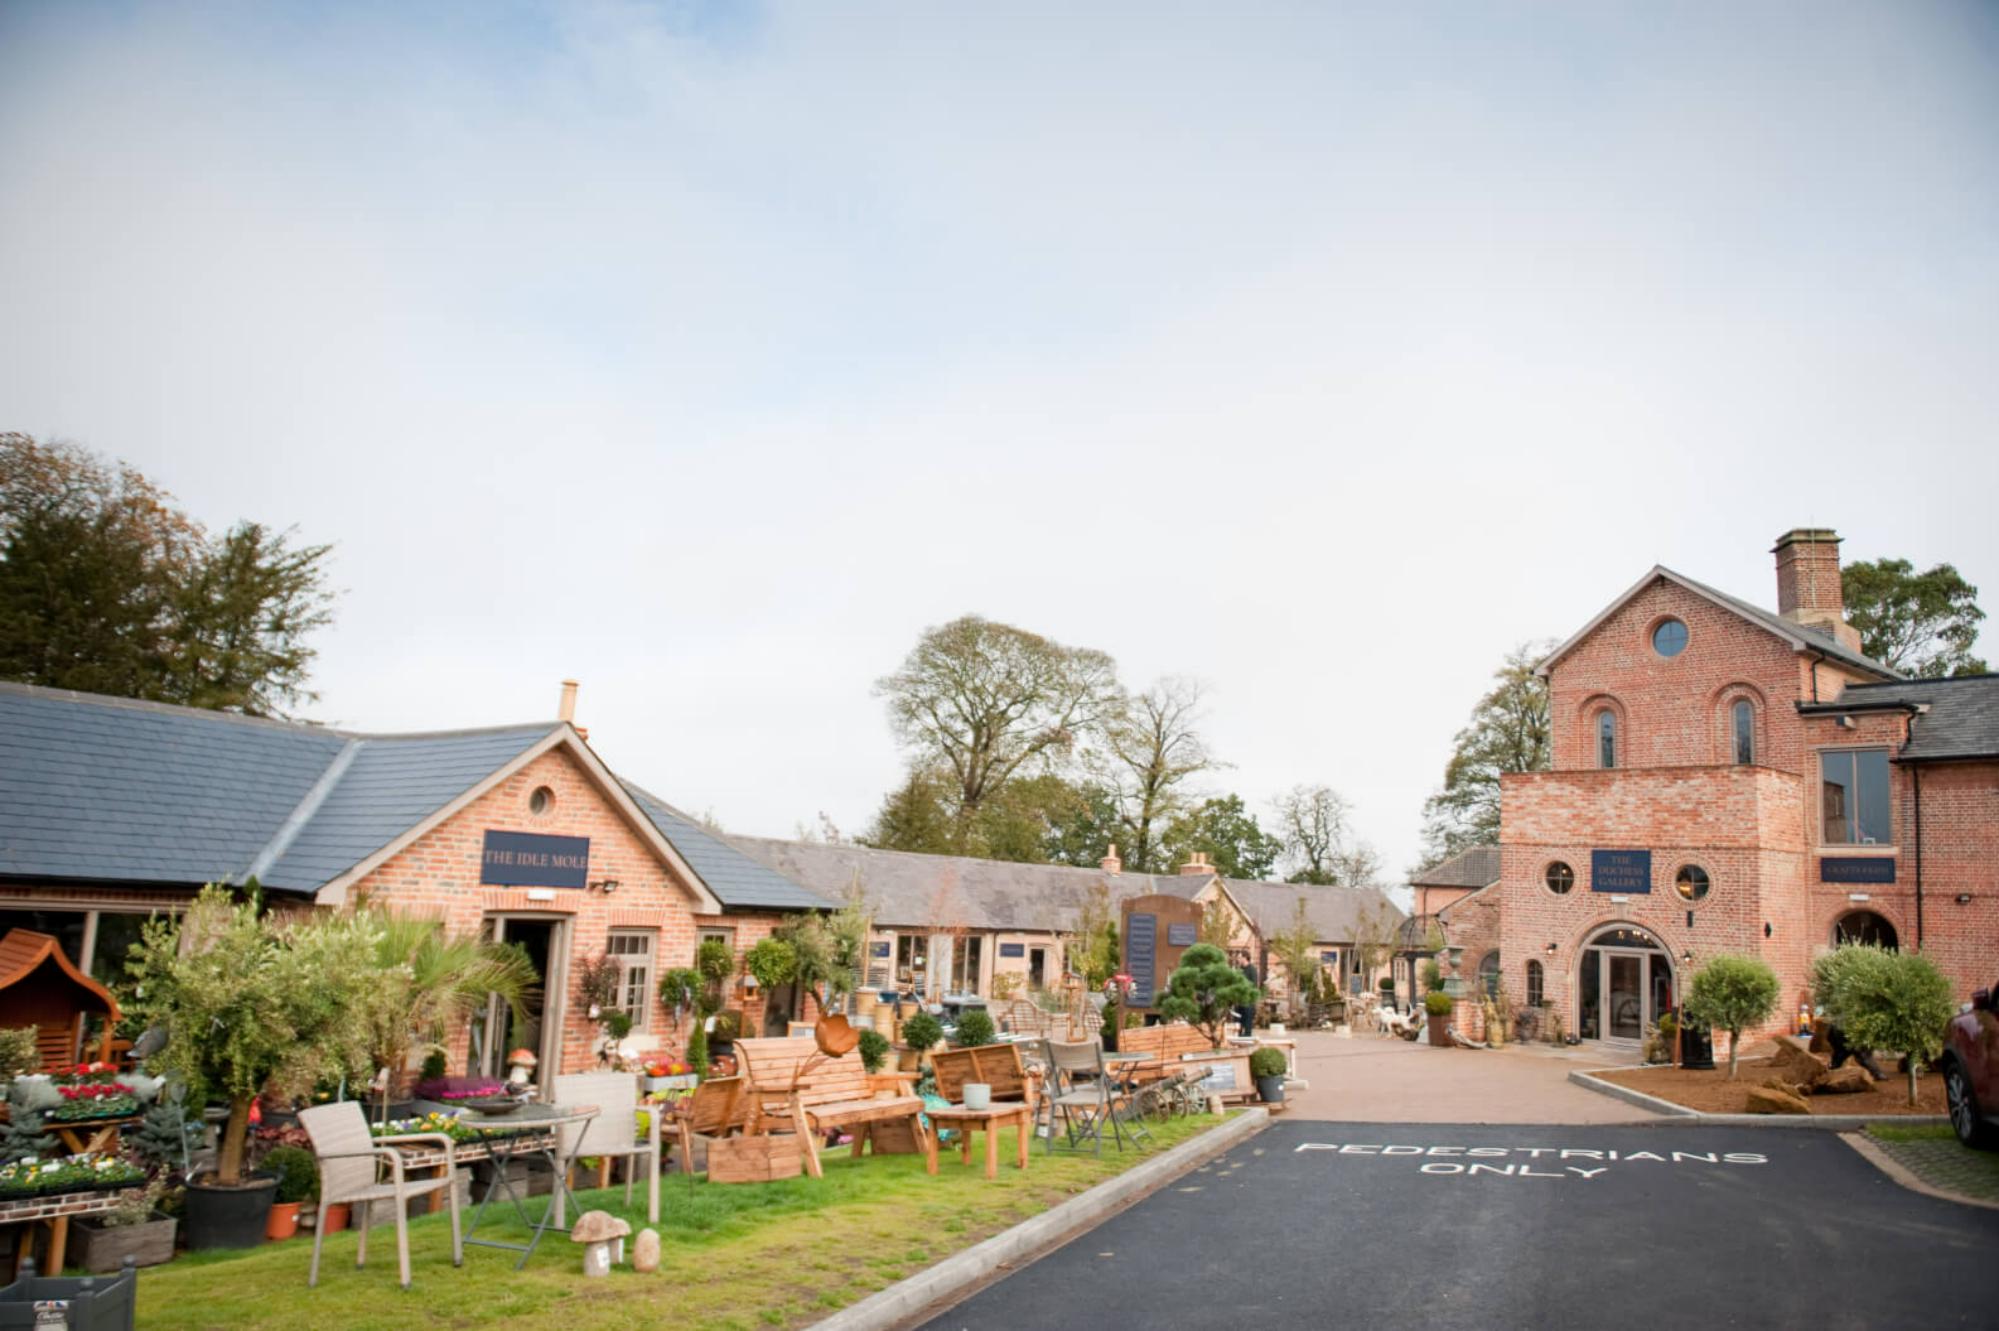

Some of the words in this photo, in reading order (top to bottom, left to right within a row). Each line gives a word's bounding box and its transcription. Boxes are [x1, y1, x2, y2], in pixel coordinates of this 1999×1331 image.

[485, 850, 513, 865] THE
[517, 852, 549, 867] IDLE
[1295, 1143, 1769, 1163] PEDESTRIANS
[1420, 1162, 1608, 1178] ONLY
